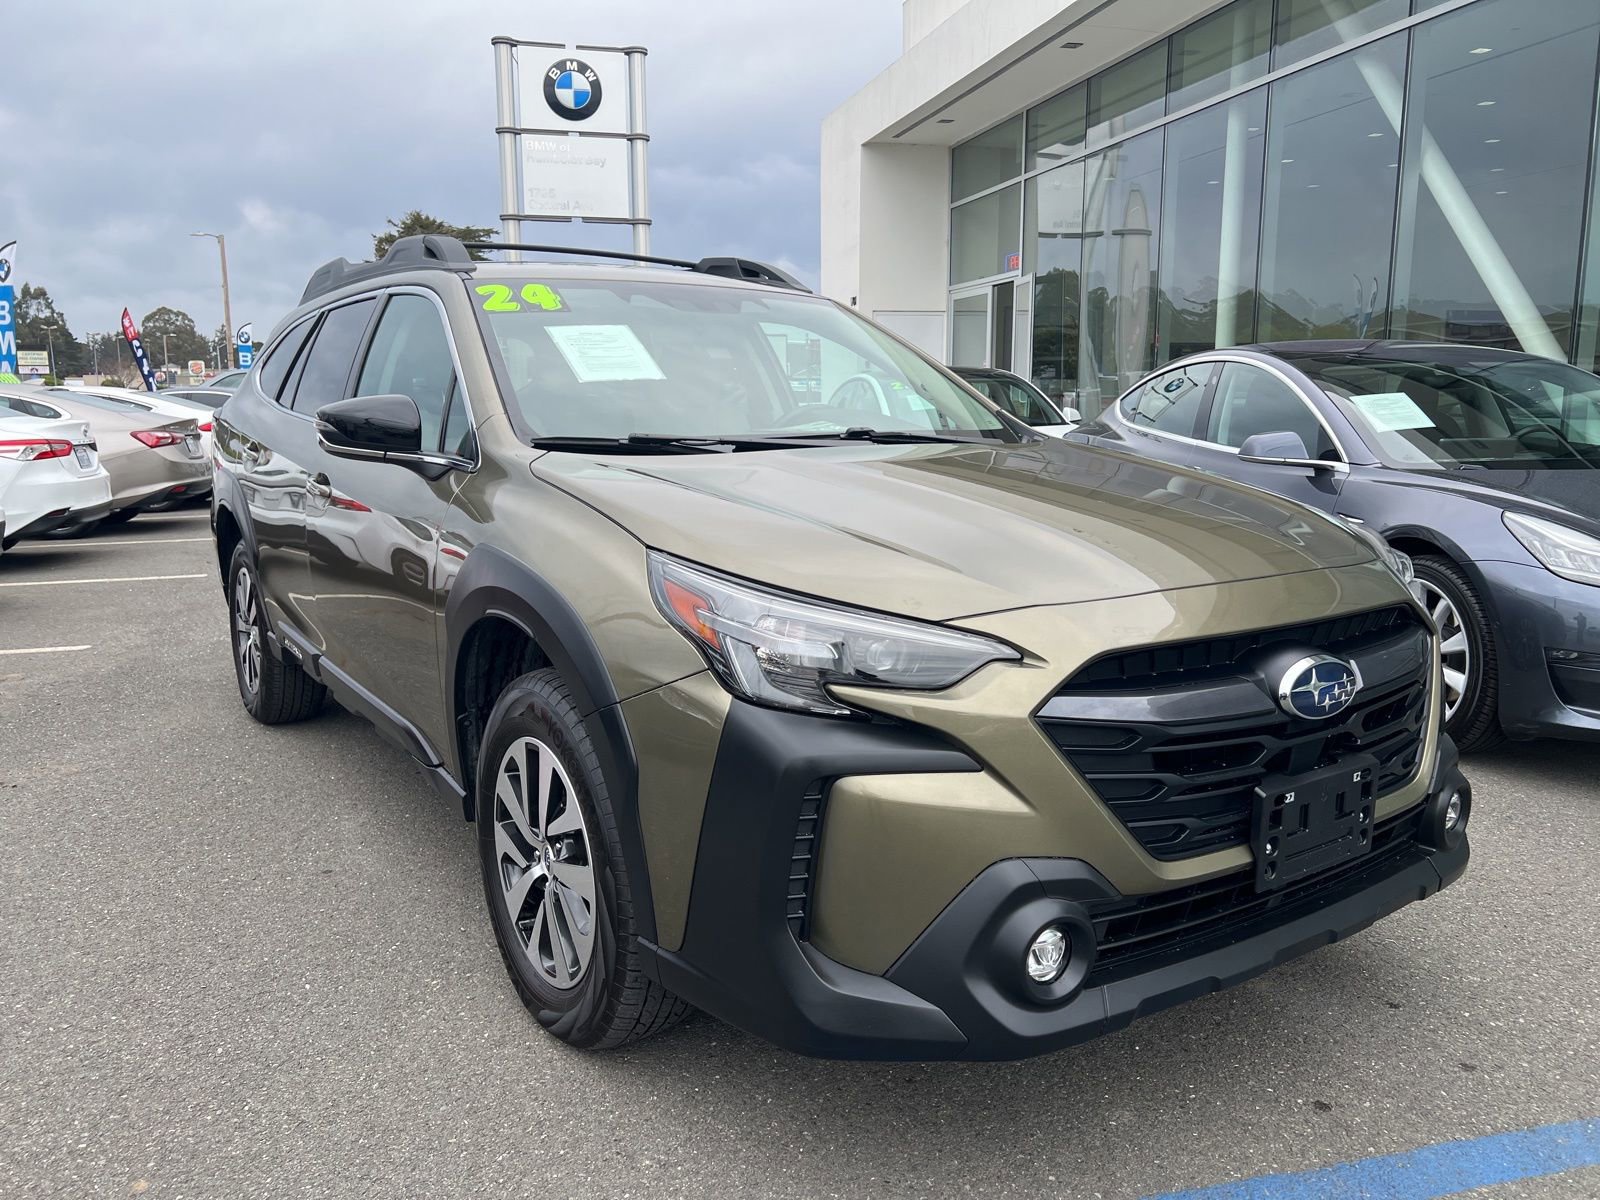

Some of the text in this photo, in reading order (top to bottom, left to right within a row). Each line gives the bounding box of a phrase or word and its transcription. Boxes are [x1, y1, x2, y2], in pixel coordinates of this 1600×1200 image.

[548, 61, 597, 82] BMW
[525, 140, 557, 151] BMW
[475, 283, 562, 312] 24
